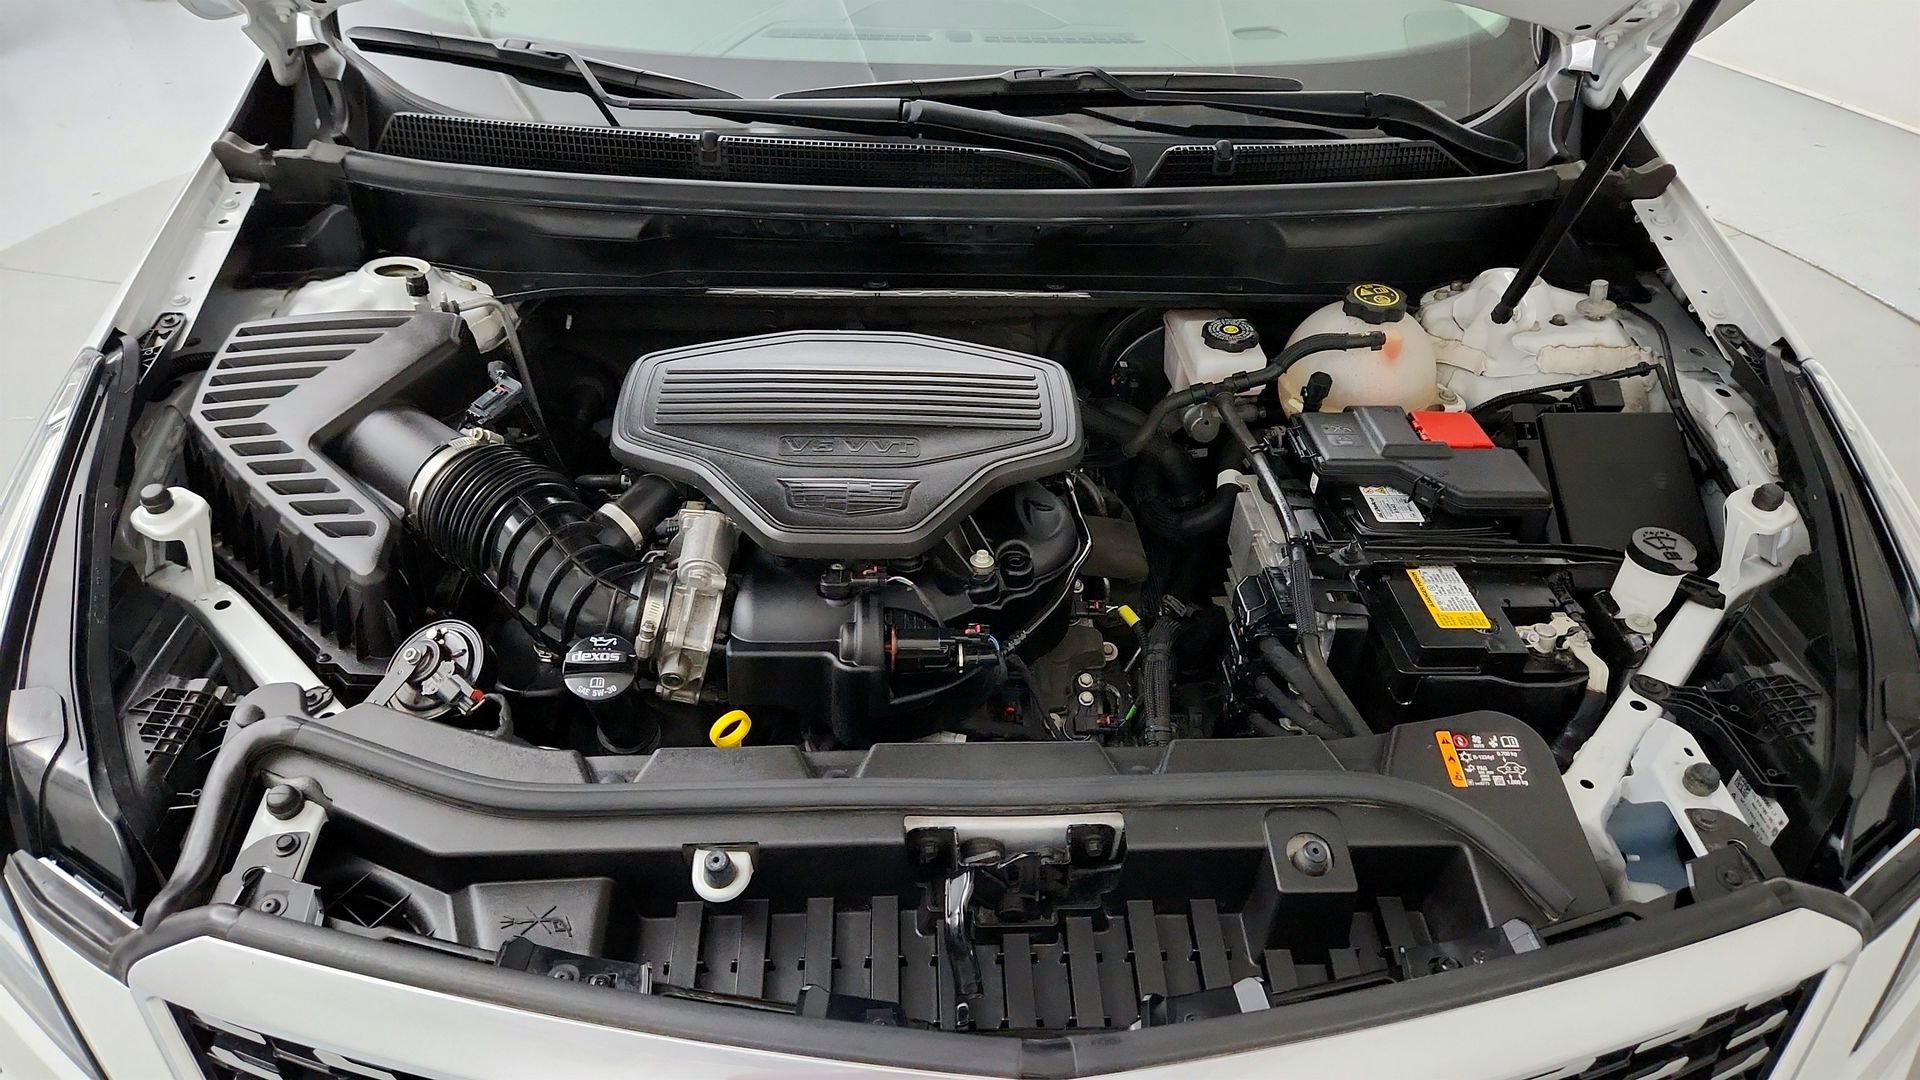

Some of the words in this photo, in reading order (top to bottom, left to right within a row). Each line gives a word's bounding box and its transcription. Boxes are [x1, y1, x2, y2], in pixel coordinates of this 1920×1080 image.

[571, 651, 620, 661] dexos
[576, 685, 590, 696] SAE
[592, 684, 617, 697] 5W-30
